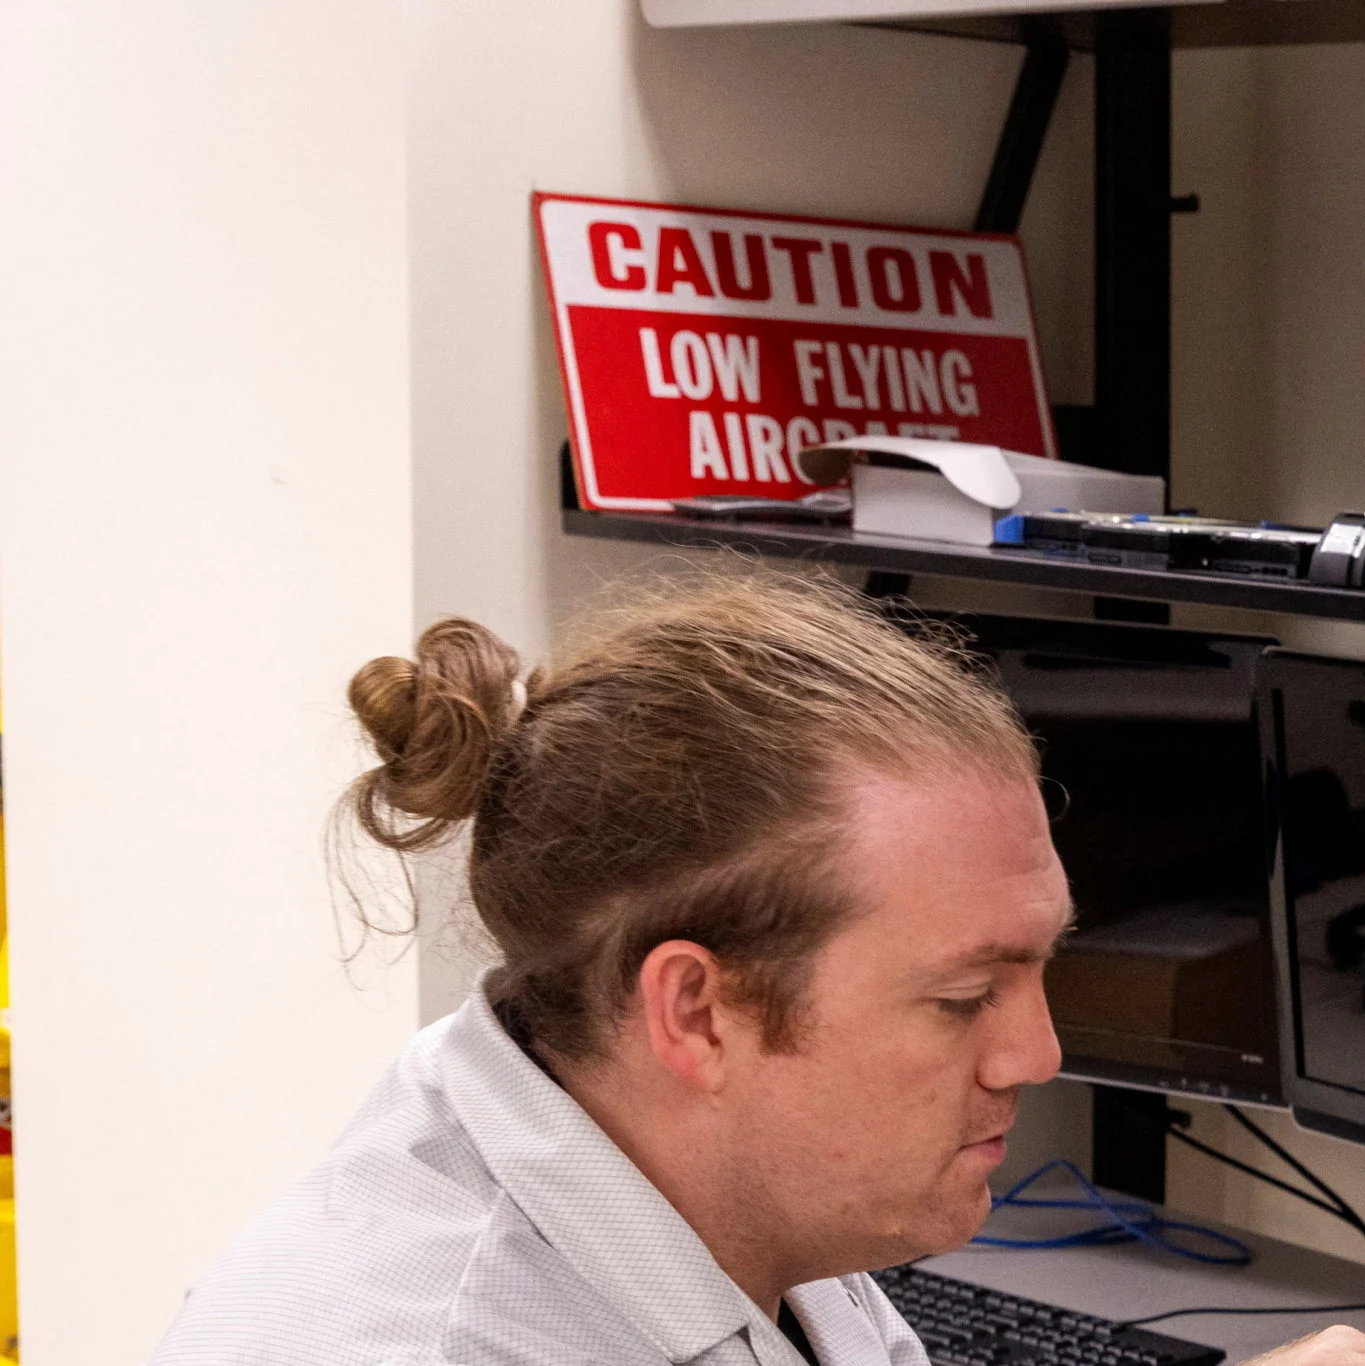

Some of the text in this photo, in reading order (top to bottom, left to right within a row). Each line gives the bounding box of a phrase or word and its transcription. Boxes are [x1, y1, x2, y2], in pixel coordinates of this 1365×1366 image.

[588, 221, 993, 319] CAUTION
[640, 327, 979, 417] LOW FLYING
[688, 411, 960, 485] AIRC
